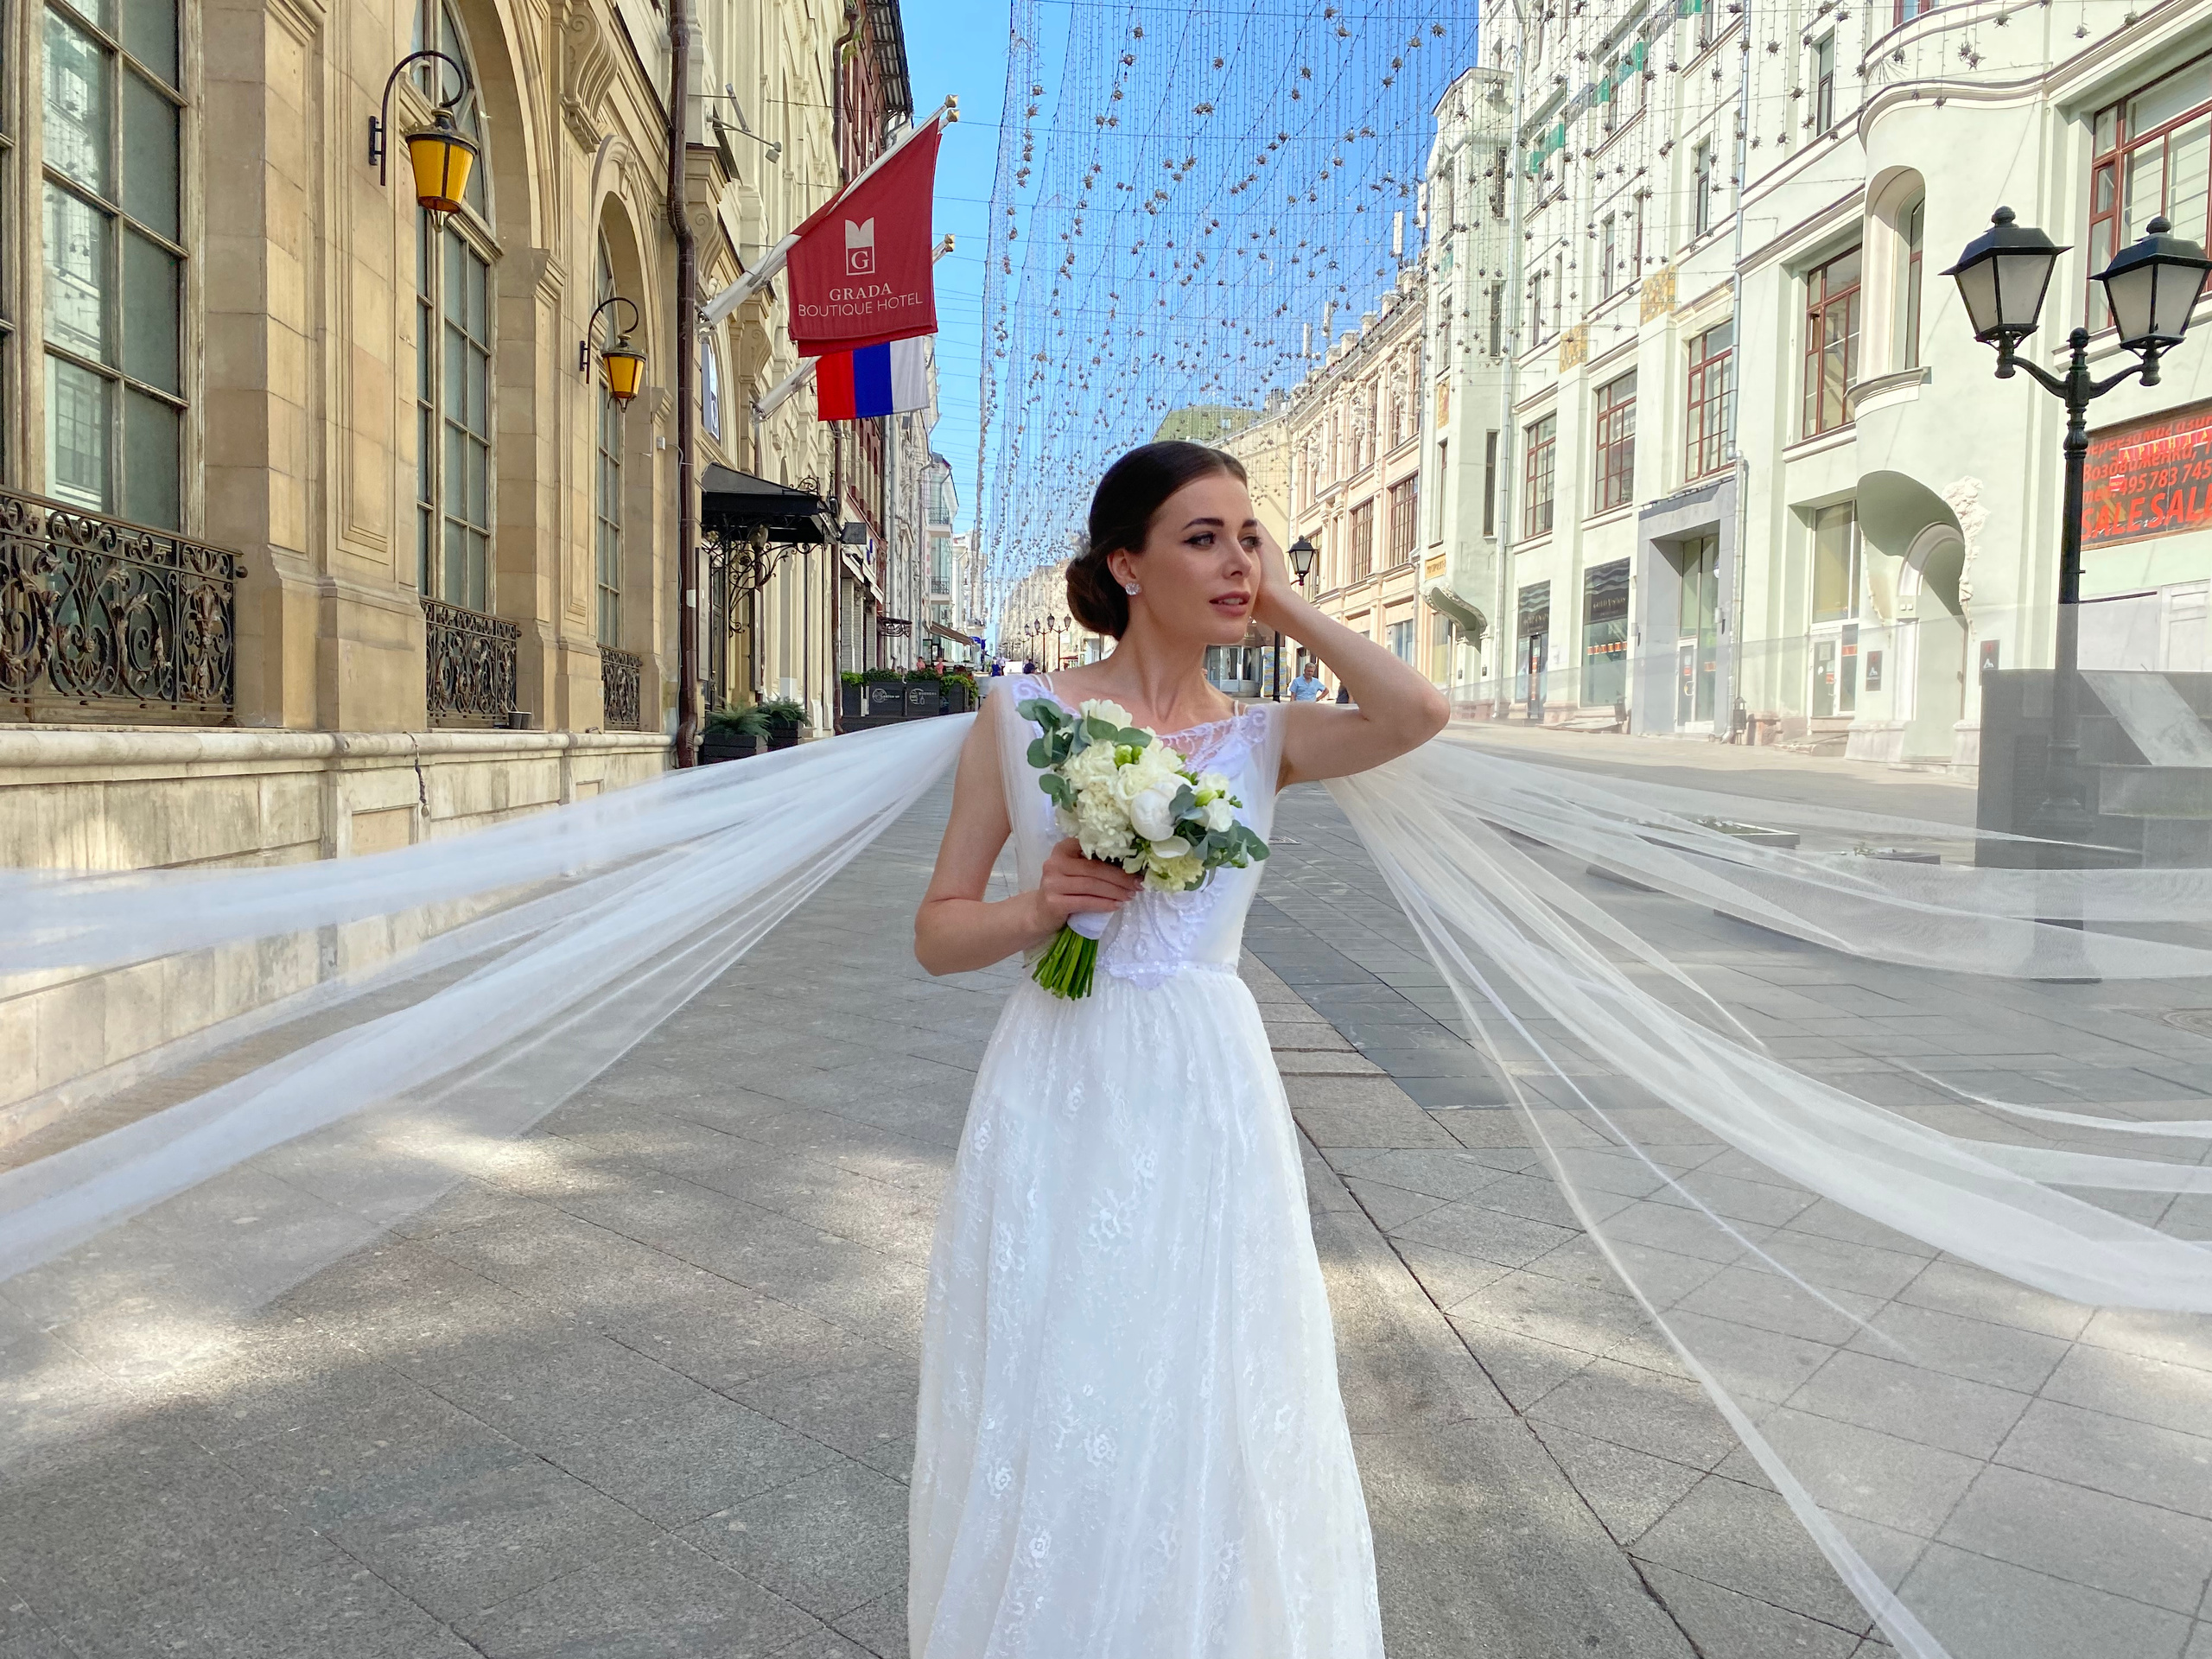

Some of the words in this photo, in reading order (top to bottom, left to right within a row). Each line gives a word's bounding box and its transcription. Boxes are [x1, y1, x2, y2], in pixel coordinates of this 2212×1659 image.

[851, 251, 869, 270] G
[829, 282, 893, 302] GRADA
[798, 302, 873, 317] BOUTIQUE
[877, 292, 923, 312] HOTEL
[2150, 467, 2178, 490] 783
[2081, 497, 2145, 542] SALE
